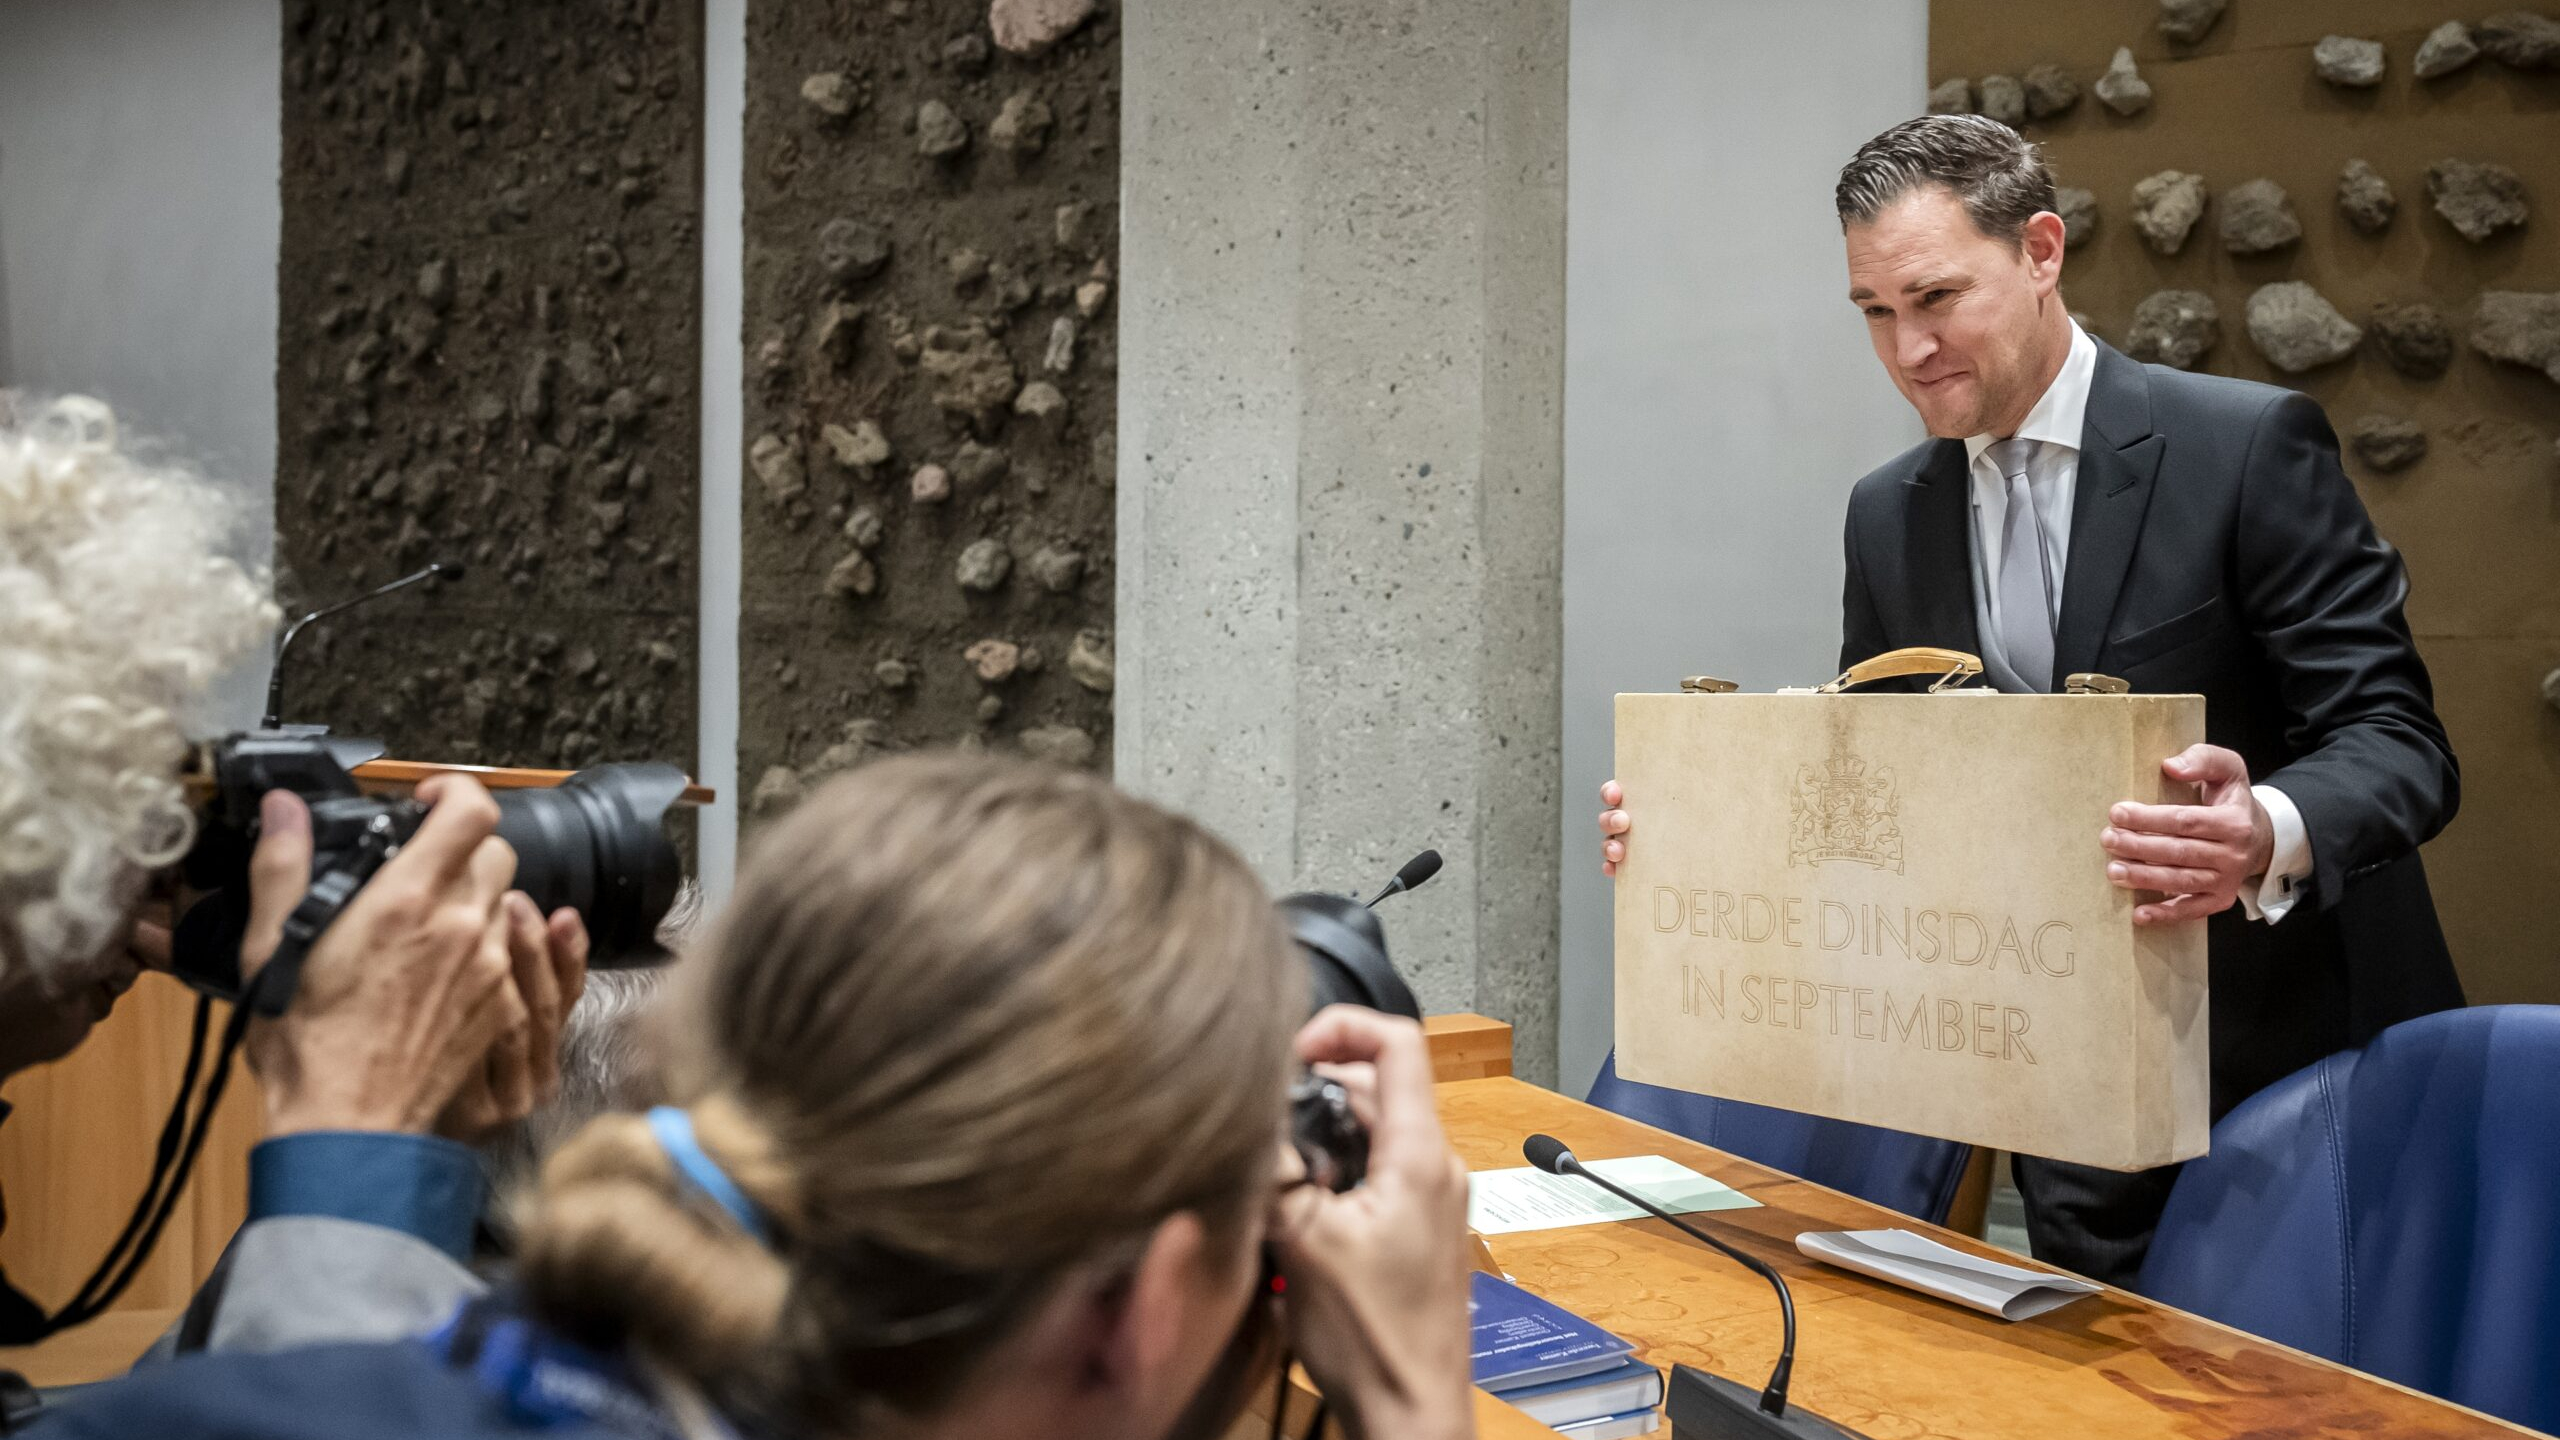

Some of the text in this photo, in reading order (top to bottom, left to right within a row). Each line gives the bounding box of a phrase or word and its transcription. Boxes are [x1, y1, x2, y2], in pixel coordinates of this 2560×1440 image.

[1653, 885, 2076, 979] DERDE DINSDAG
[1681, 965, 2038, 1066] IN SEPTEMBER
